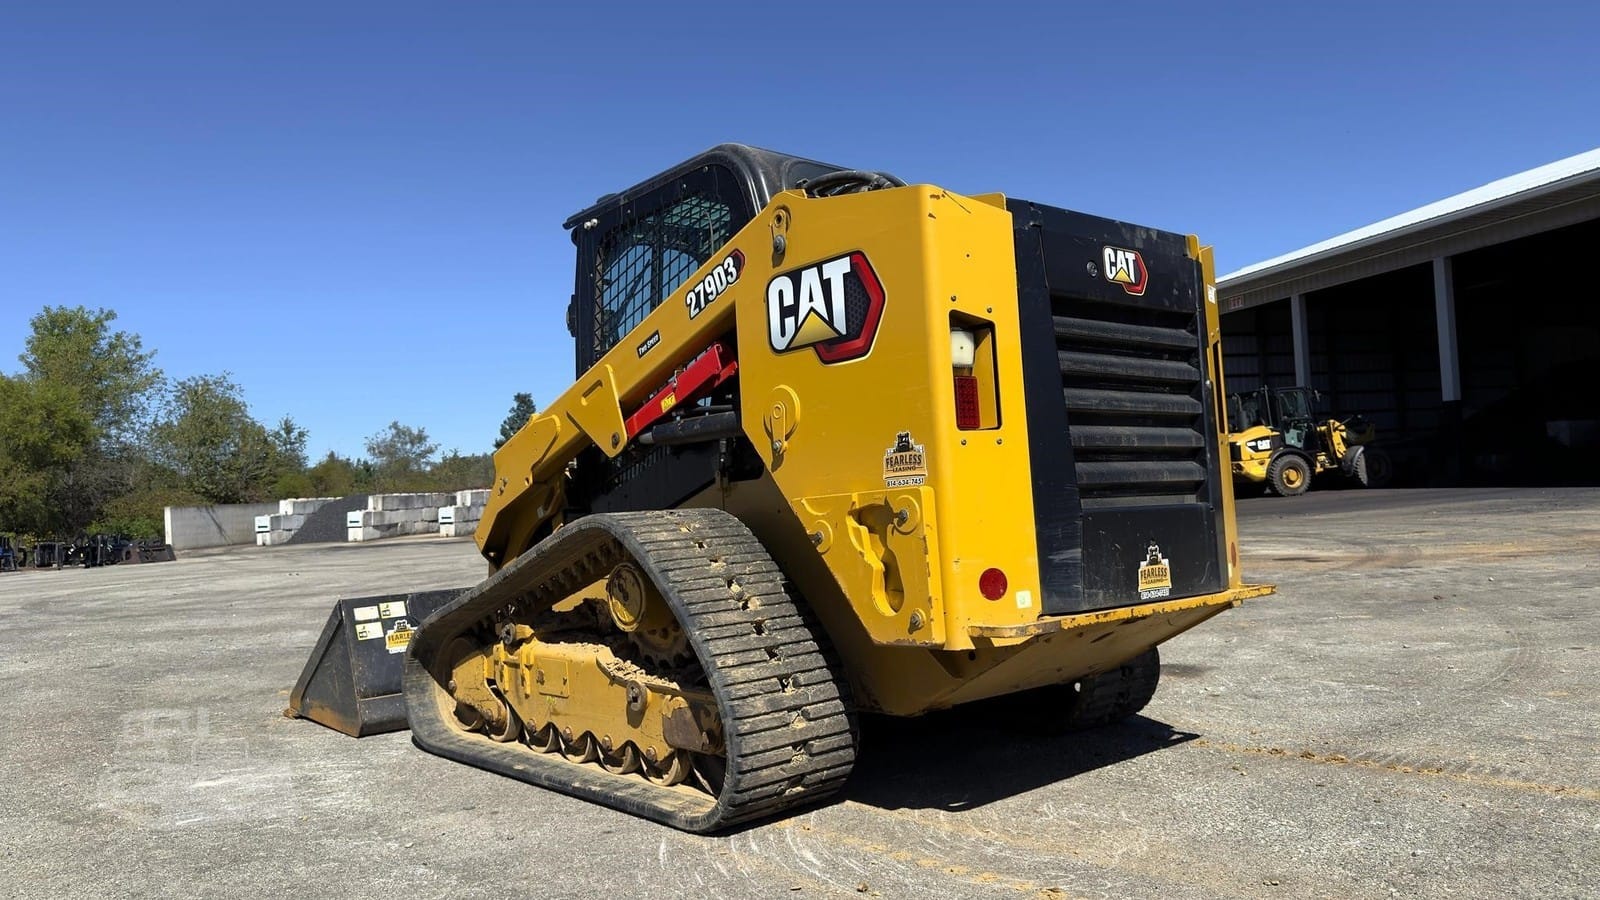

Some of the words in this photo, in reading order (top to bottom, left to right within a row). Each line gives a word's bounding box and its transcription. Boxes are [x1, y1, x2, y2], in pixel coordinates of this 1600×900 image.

[1104, 247, 1136, 284] CAT
[686, 256, 738, 319] 279D3
[768, 256, 851, 351] CAT
[885, 454, 922, 469] FEARLESS
[887, 477, 924, 487] 814-634-7451
[1140, 567, 1168, 580] FEARLESS
[387, 632, 411, 643] FEARLE
